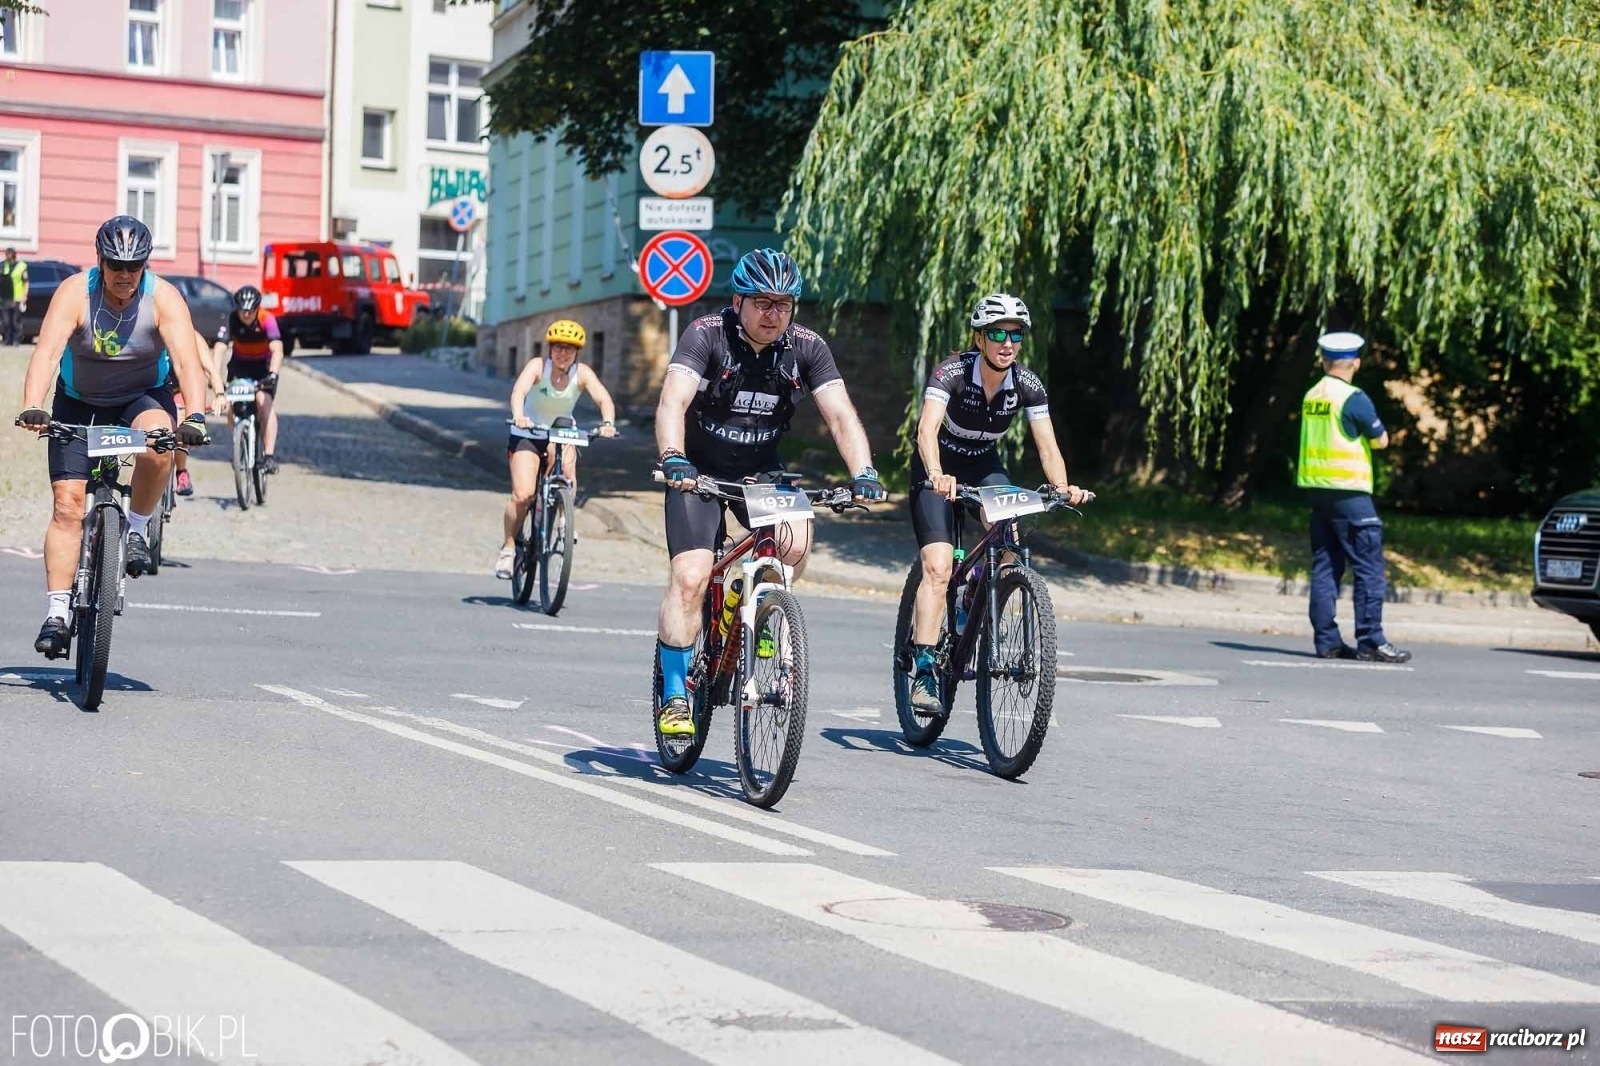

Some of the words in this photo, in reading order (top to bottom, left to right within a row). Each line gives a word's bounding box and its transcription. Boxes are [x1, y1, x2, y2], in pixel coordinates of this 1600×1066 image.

[645, 202, 662, 212] Nie
[667, 203, 707, 214] dotyczy
[100, 434, 133, 446] 2161
[705, 422, 778, 444] JACQUET
[759, 495, 797, 510] 1937
[993, 492, 1029, 507] 1776
